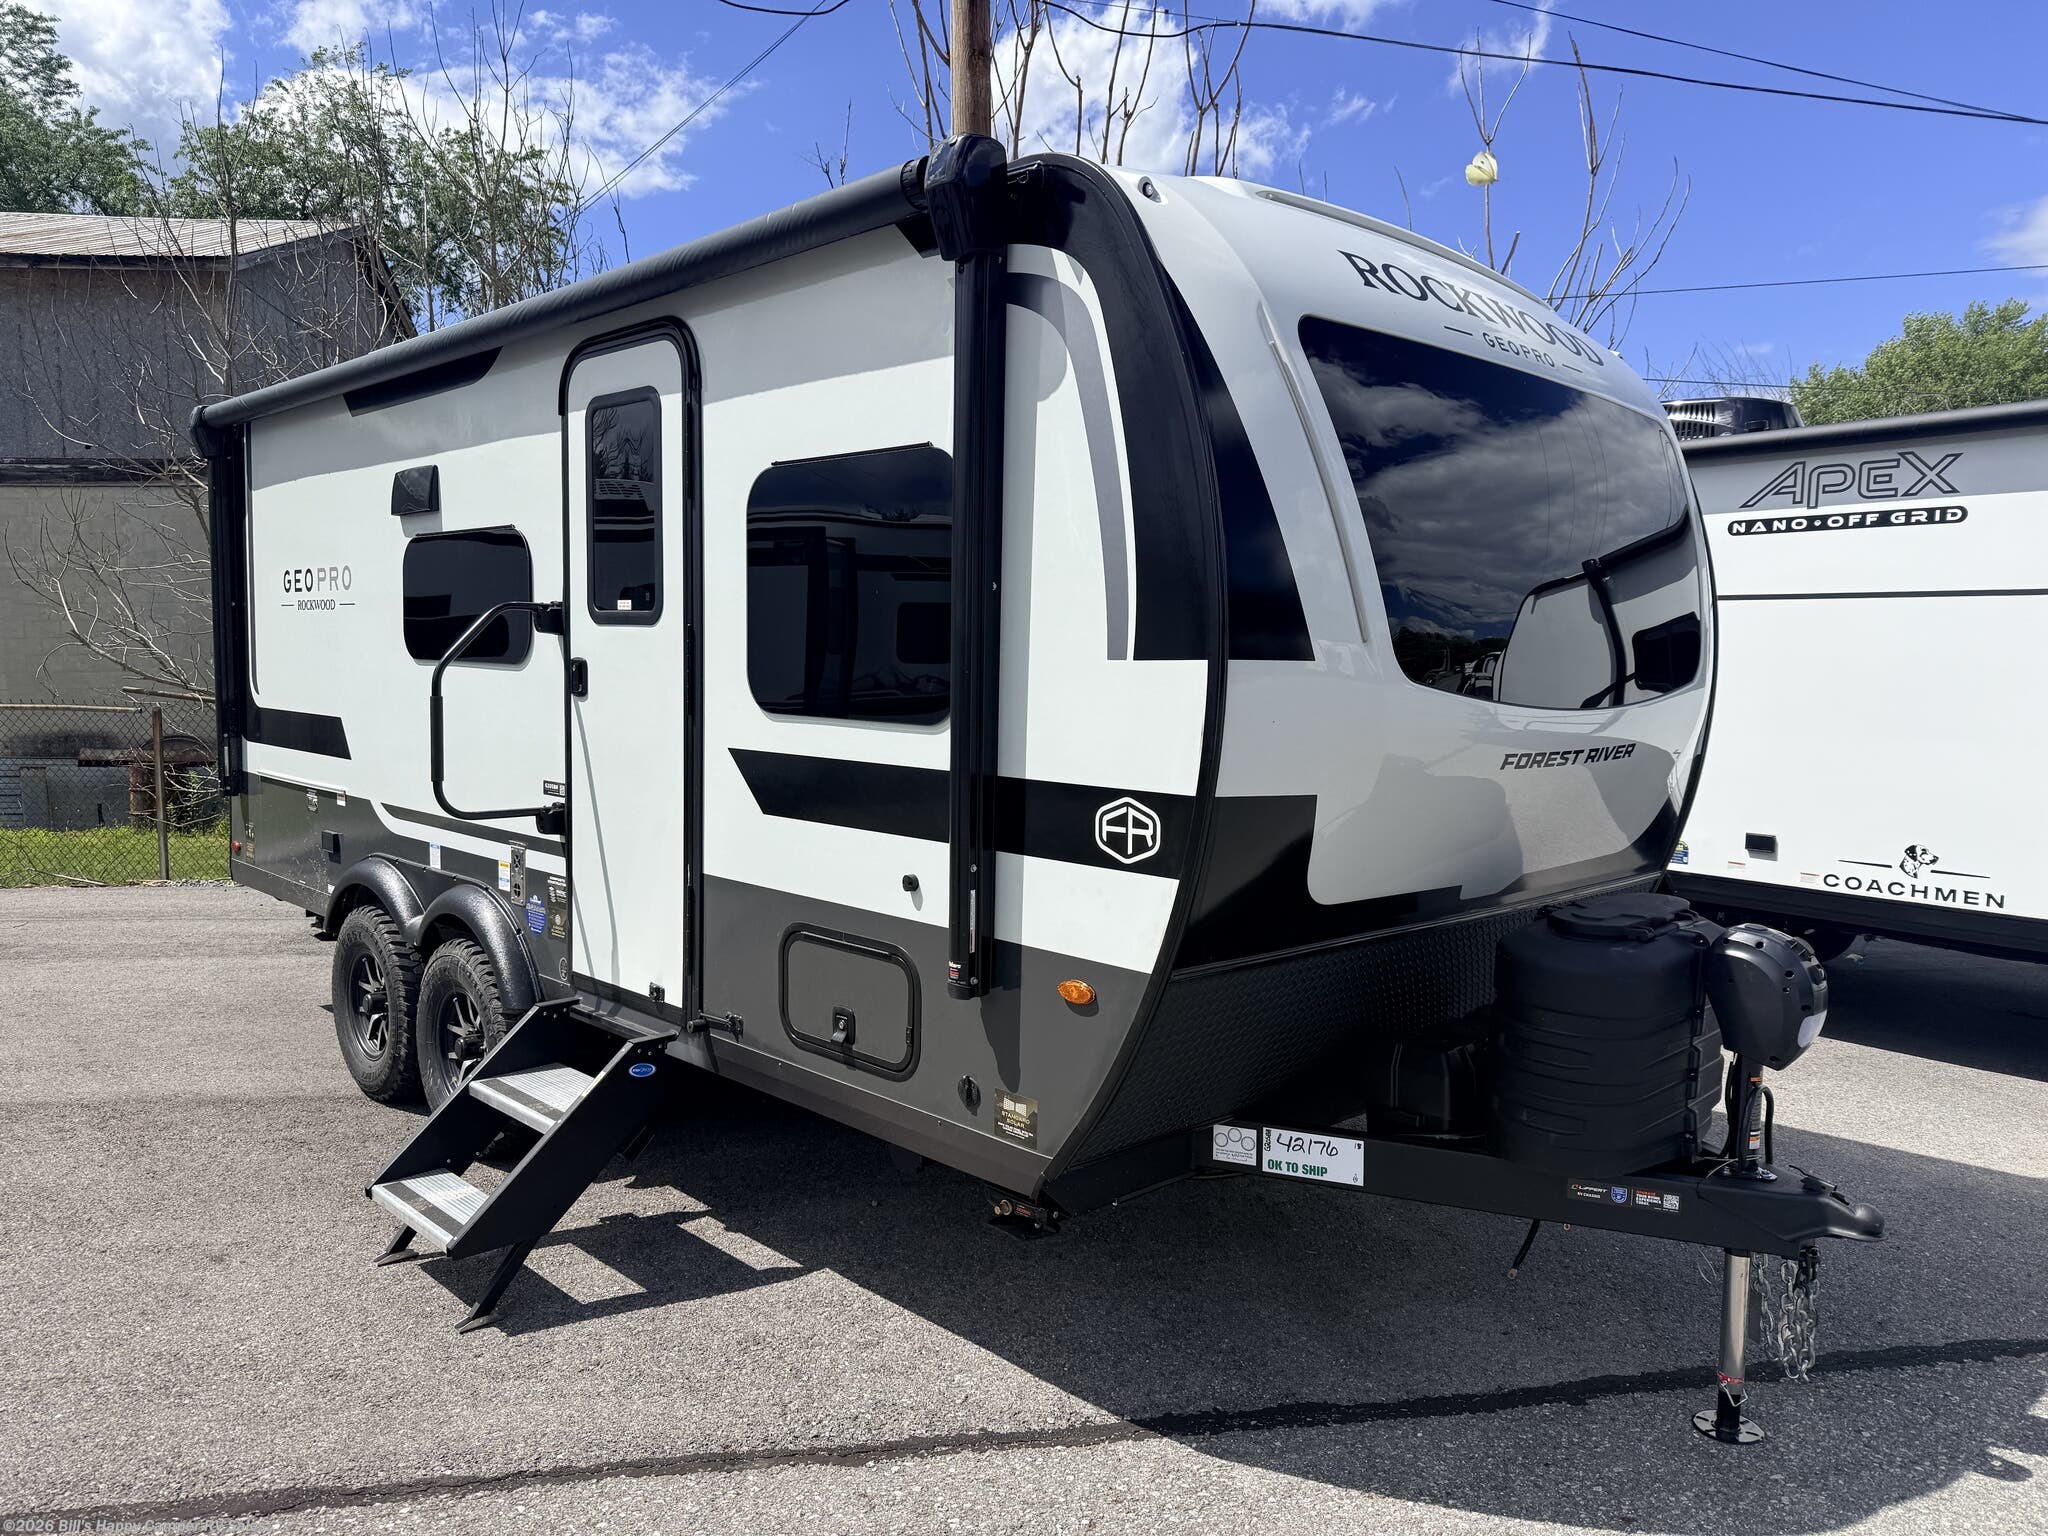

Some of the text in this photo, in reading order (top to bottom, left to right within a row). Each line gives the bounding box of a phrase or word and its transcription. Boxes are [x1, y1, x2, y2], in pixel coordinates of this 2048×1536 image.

[1336, 249, 1604, 367] ROCKWOOD
[1482, 331, 1555, 368] GEOPRO
[1739, 450, 1964, 509] APEX
[1826, 513, 1881, 528] OFF
[1890, 508, 1963, 524] GRID
[283, 565, 352, 593] GEOPRO
[297, 599, 336, 611] ROCKWOOD
[1500, 743, 1637, 770] FOREST RIVER
[1822, 873, 2006, 909] COACHMEN
[1276, 1133, 1339, 1157] 42176
[1267, 1158, 1328, 1177] OK TO SHIP
[1579, 1185, 1609, 1193] LIPPERT
